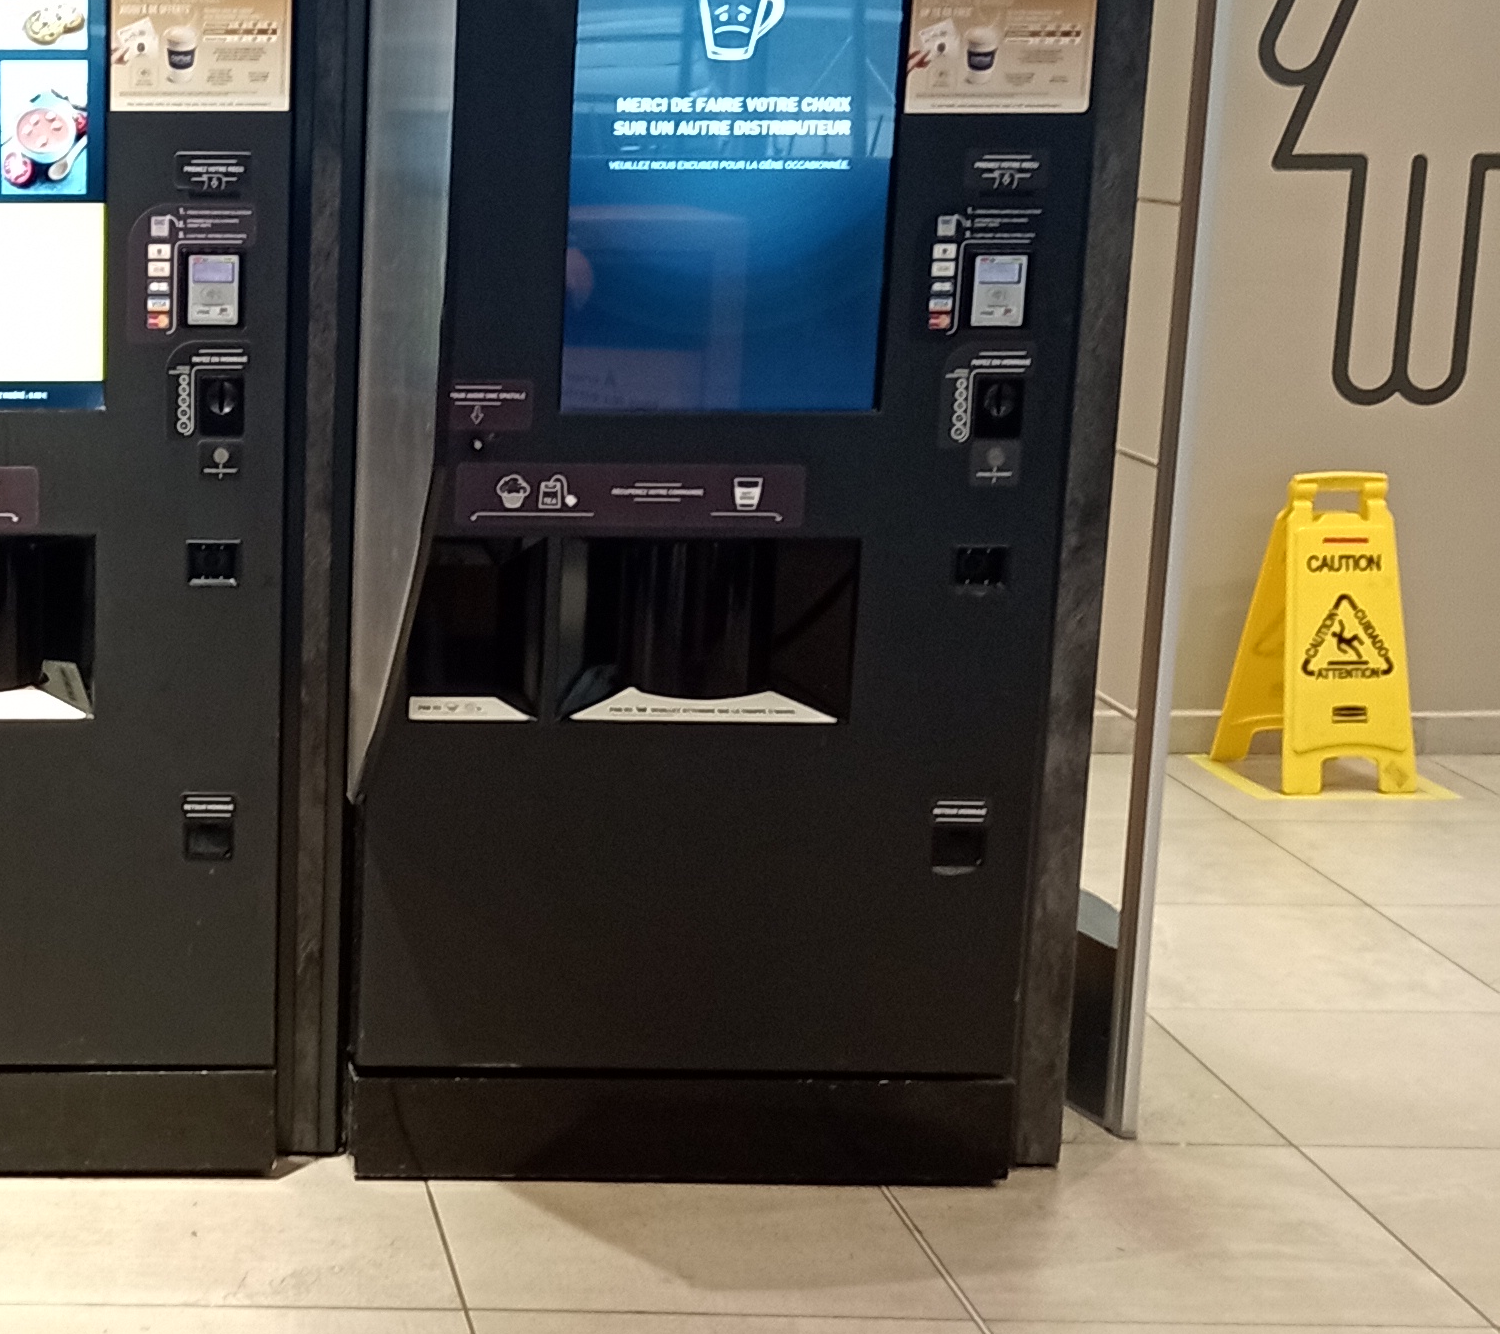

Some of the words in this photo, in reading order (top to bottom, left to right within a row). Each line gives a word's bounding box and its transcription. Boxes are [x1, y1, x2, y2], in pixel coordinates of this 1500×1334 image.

[616, 97, 668, 113] MERCI
[671, 97, 693, 113] DE
[696, 97, 745, 113] FAIRE
[746, 97, 799, 113] VOTRE
[801, 97, 852, 113] CHOIX
[613, 120, 648, 136] SUR
[650, 120, 675, 136] UN
[677, 120, 731, 136] AUTRE
[733, 120, 852, 136] DISTRIBUTEUR
[608, 160, 650, 170] VEUILLEZ
[650, 160, 677, 170] NOUS
[677, 160, 719, 170] EXCUSER
[719, 160, 745, 170] POUR
[746, 160, 758, 170] LA
[759, 160, 784, 170] GÊNE
[1306, 554, 1382, 573] CAUTION
[1305, 609, 1339, 659] CAUTION
[1354, 608, 1390, 658] CUIDADO
[1315, 668, 1381, 681] ATTENTION
